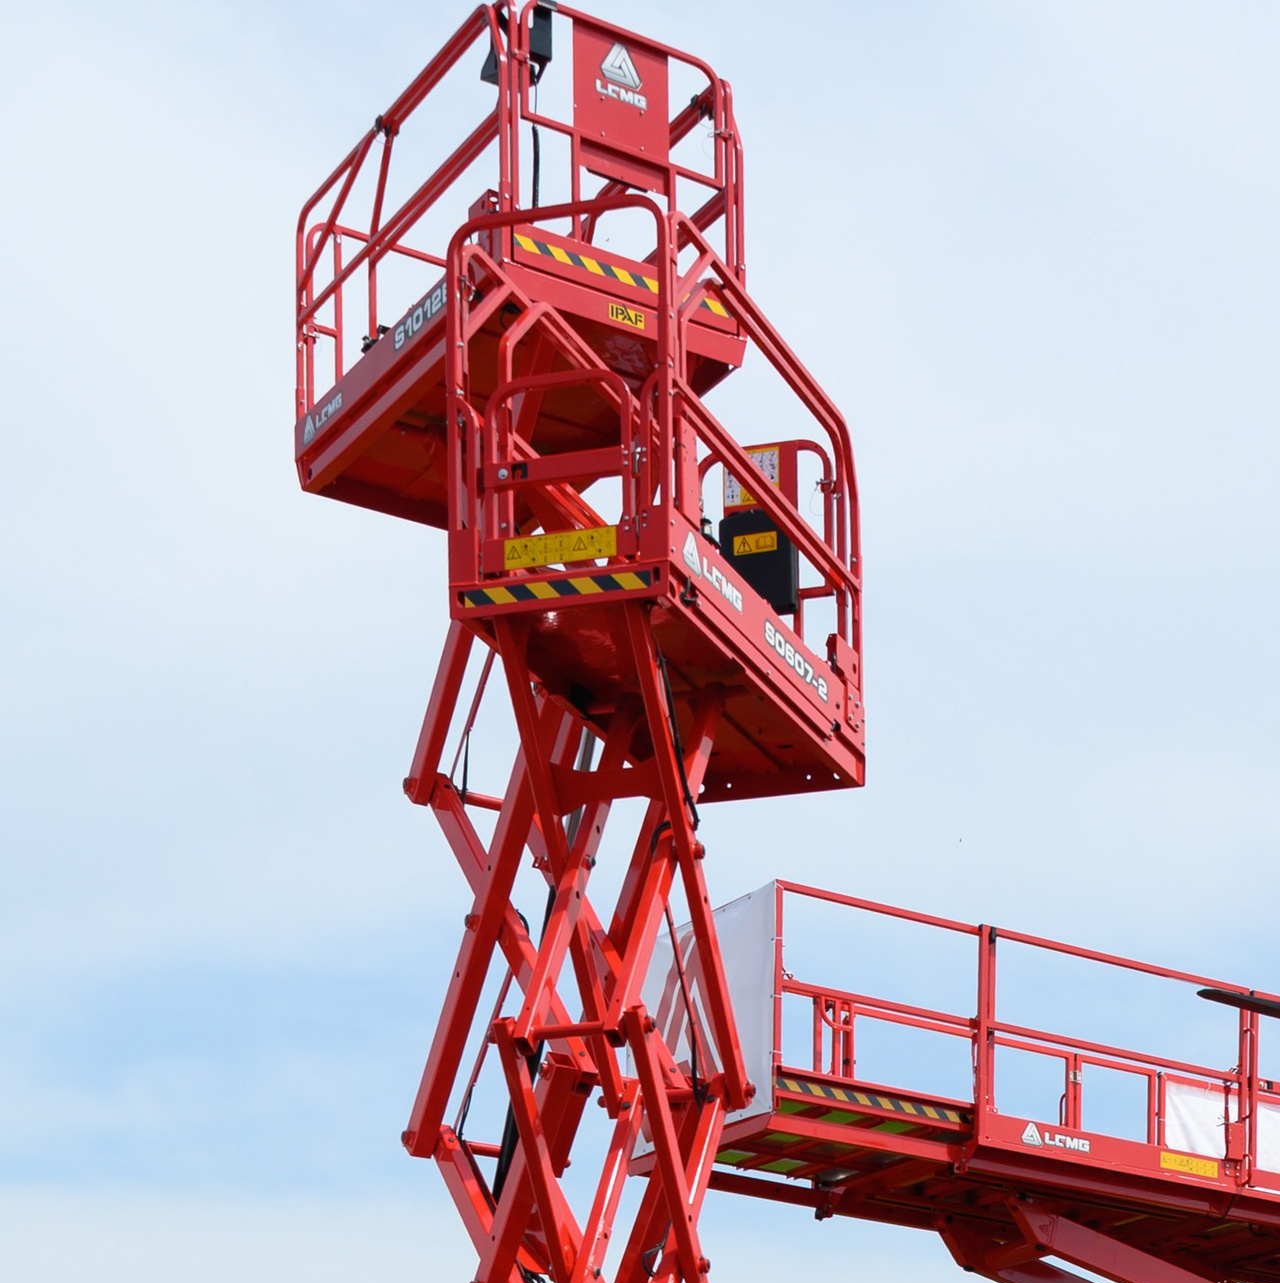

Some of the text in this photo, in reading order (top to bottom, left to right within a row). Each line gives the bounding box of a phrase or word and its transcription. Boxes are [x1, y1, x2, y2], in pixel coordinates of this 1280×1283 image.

[595, 77, 647, 111] LGMG
[610, 304, 643, 326] IPAF
[702, 556, 744, 614] LGMG
[764, 619, 828, 702] S0607-2
[1044, 1131, 1091, 1153] LGMG
